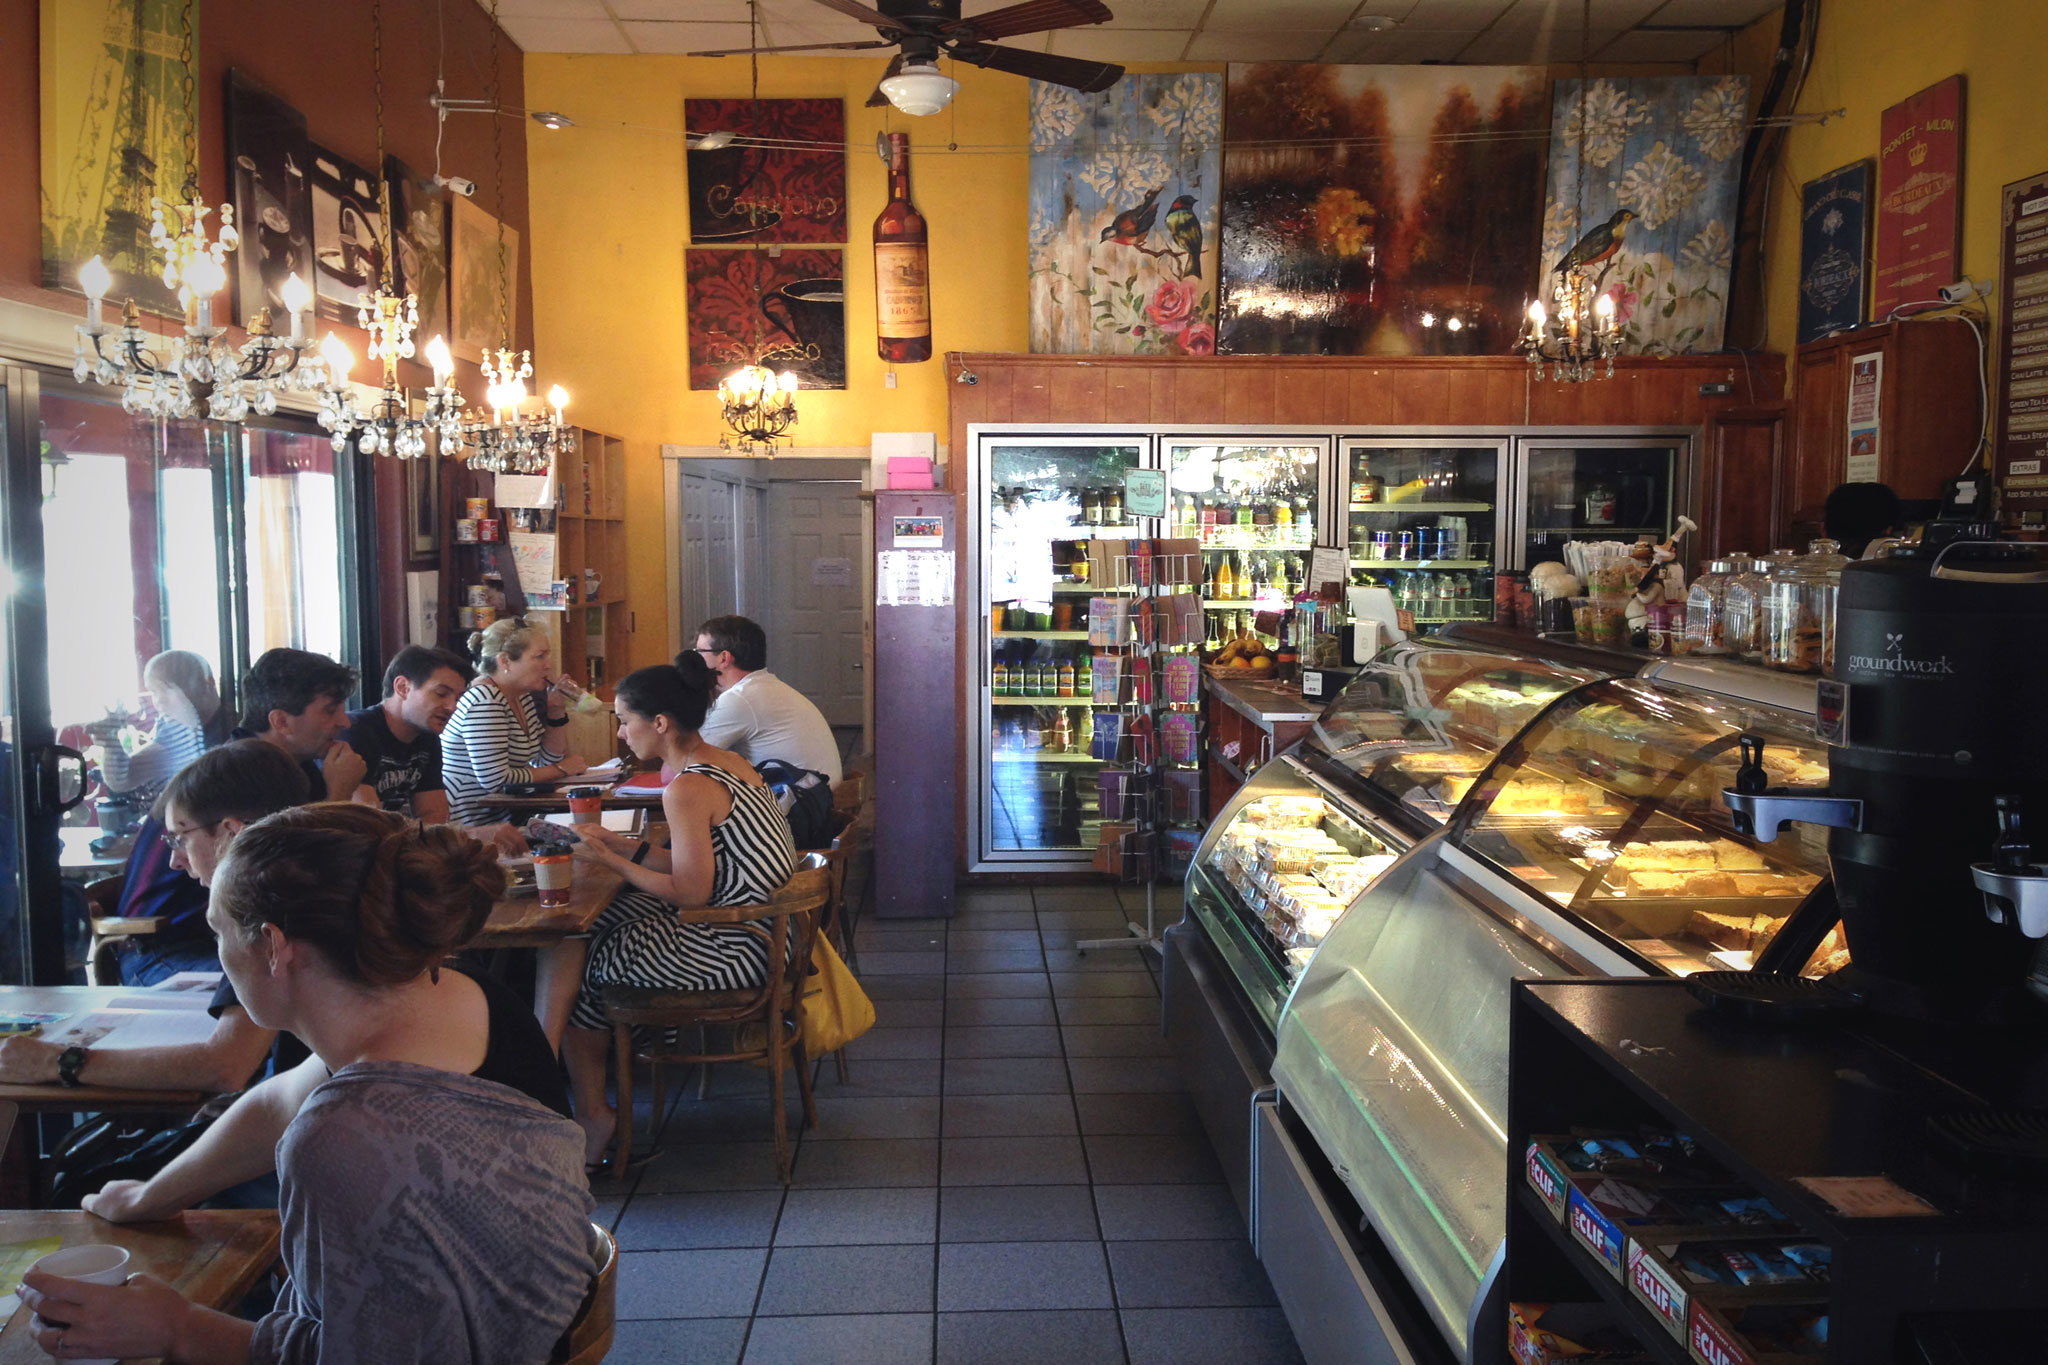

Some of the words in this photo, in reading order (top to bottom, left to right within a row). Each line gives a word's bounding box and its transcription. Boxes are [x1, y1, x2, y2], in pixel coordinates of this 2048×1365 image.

[1882, 126, 1916, 158] PONTET
[1926, 118, 1955, 132] MILON
[2024, 203, 2037, 212] HOT
[2013, 323, 2030, 332] LATTE
[2025, 370, 2044, 378] LATTE
[2009, 400, 2029, 409] GREEN
[2030, 398, 2041, 406] TEA
[2035, 449, 2046, 457] NO
[2012, 464, 2037, 473] EXTRAS
[1848, 653, 1954, 673] groundwork
[1534, 1163, 1554, 1197] CLIF
[1579, 1213, 1604, 1249] CLIF
[1641, 1271, 1669, 1312] CLIF
